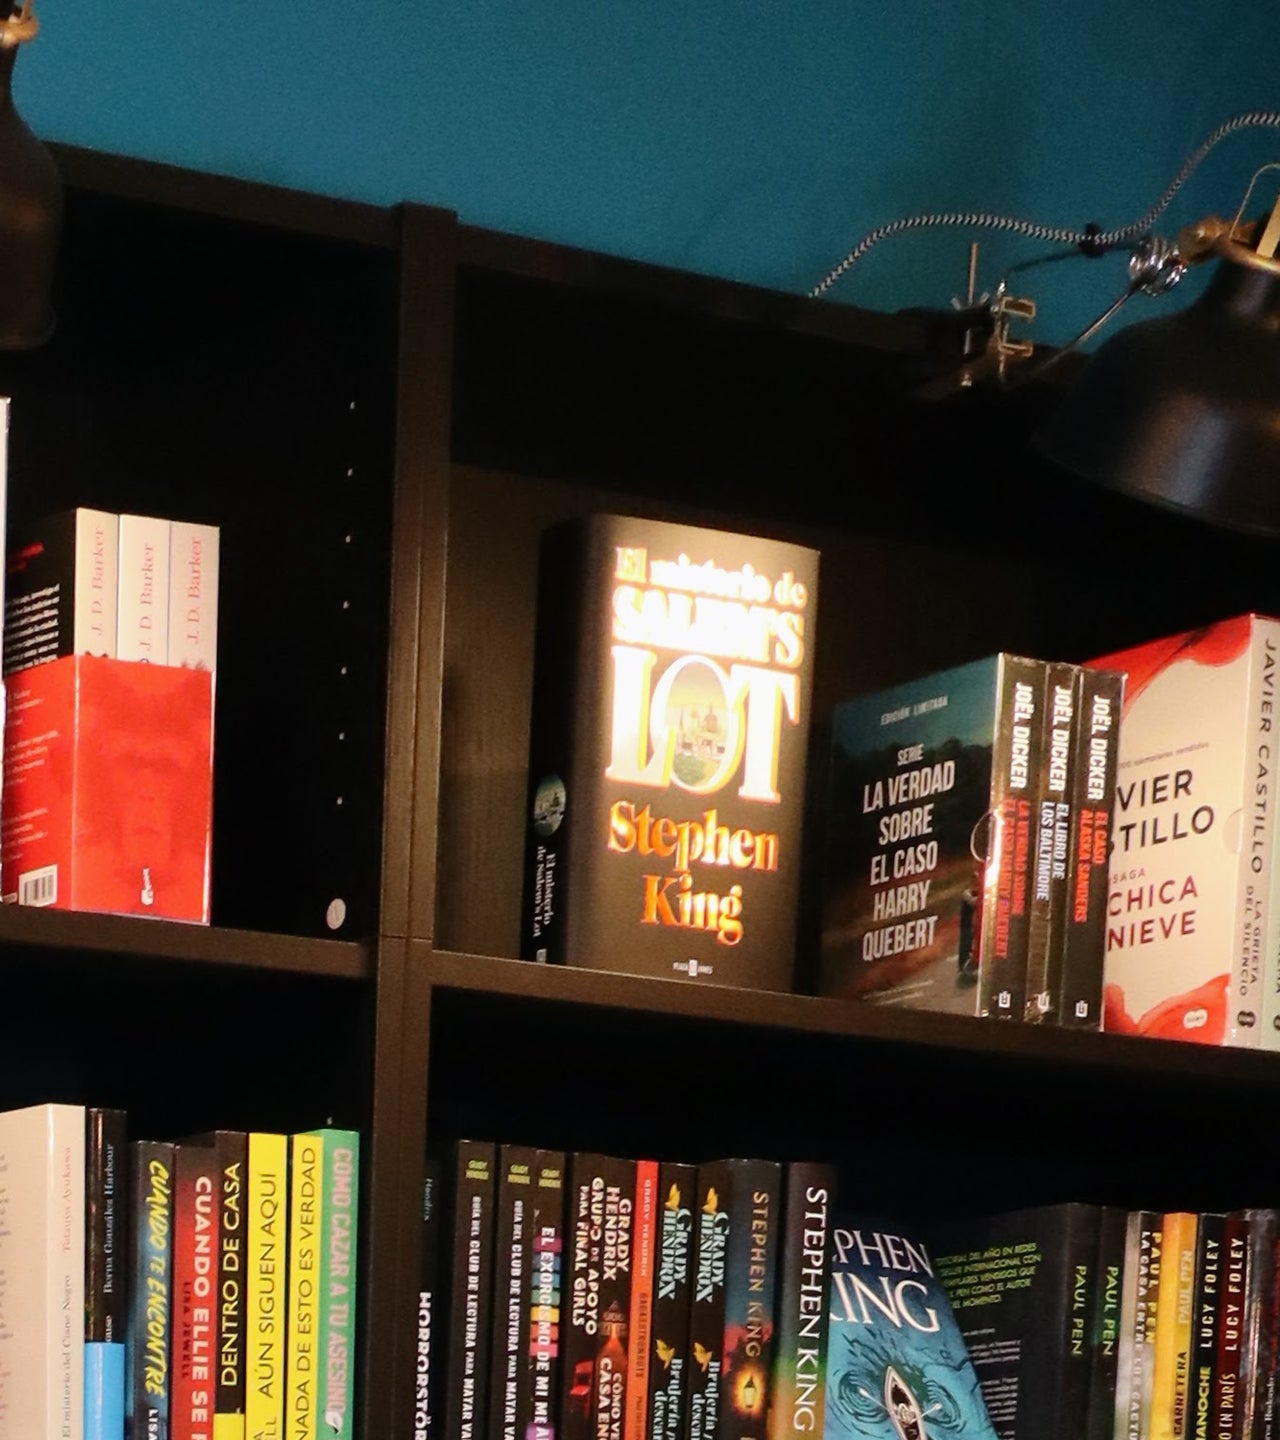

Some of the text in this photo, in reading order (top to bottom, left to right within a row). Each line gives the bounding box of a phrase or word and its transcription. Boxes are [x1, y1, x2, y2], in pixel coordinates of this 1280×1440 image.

[897, 744, 924, 766] SERIE
[1010, 682, 1034, 788] JOËL DICKER
[1252, 640, 1275, 874] JAVIER CASTILLO
[863, 760, 955, 814] LA VERDAD
[608, 800, 780, 872] Stephen
[879, 803, 933, 846] SOBRE
[871, 842, 938, 885] EL CASO
[642, 874, 743, 946] King
[873, 880, 930, 922] HARRY
[863, 916, 939, 962] QUEBERT
[794, 1187, 828, 1433] STEPHEN KING
